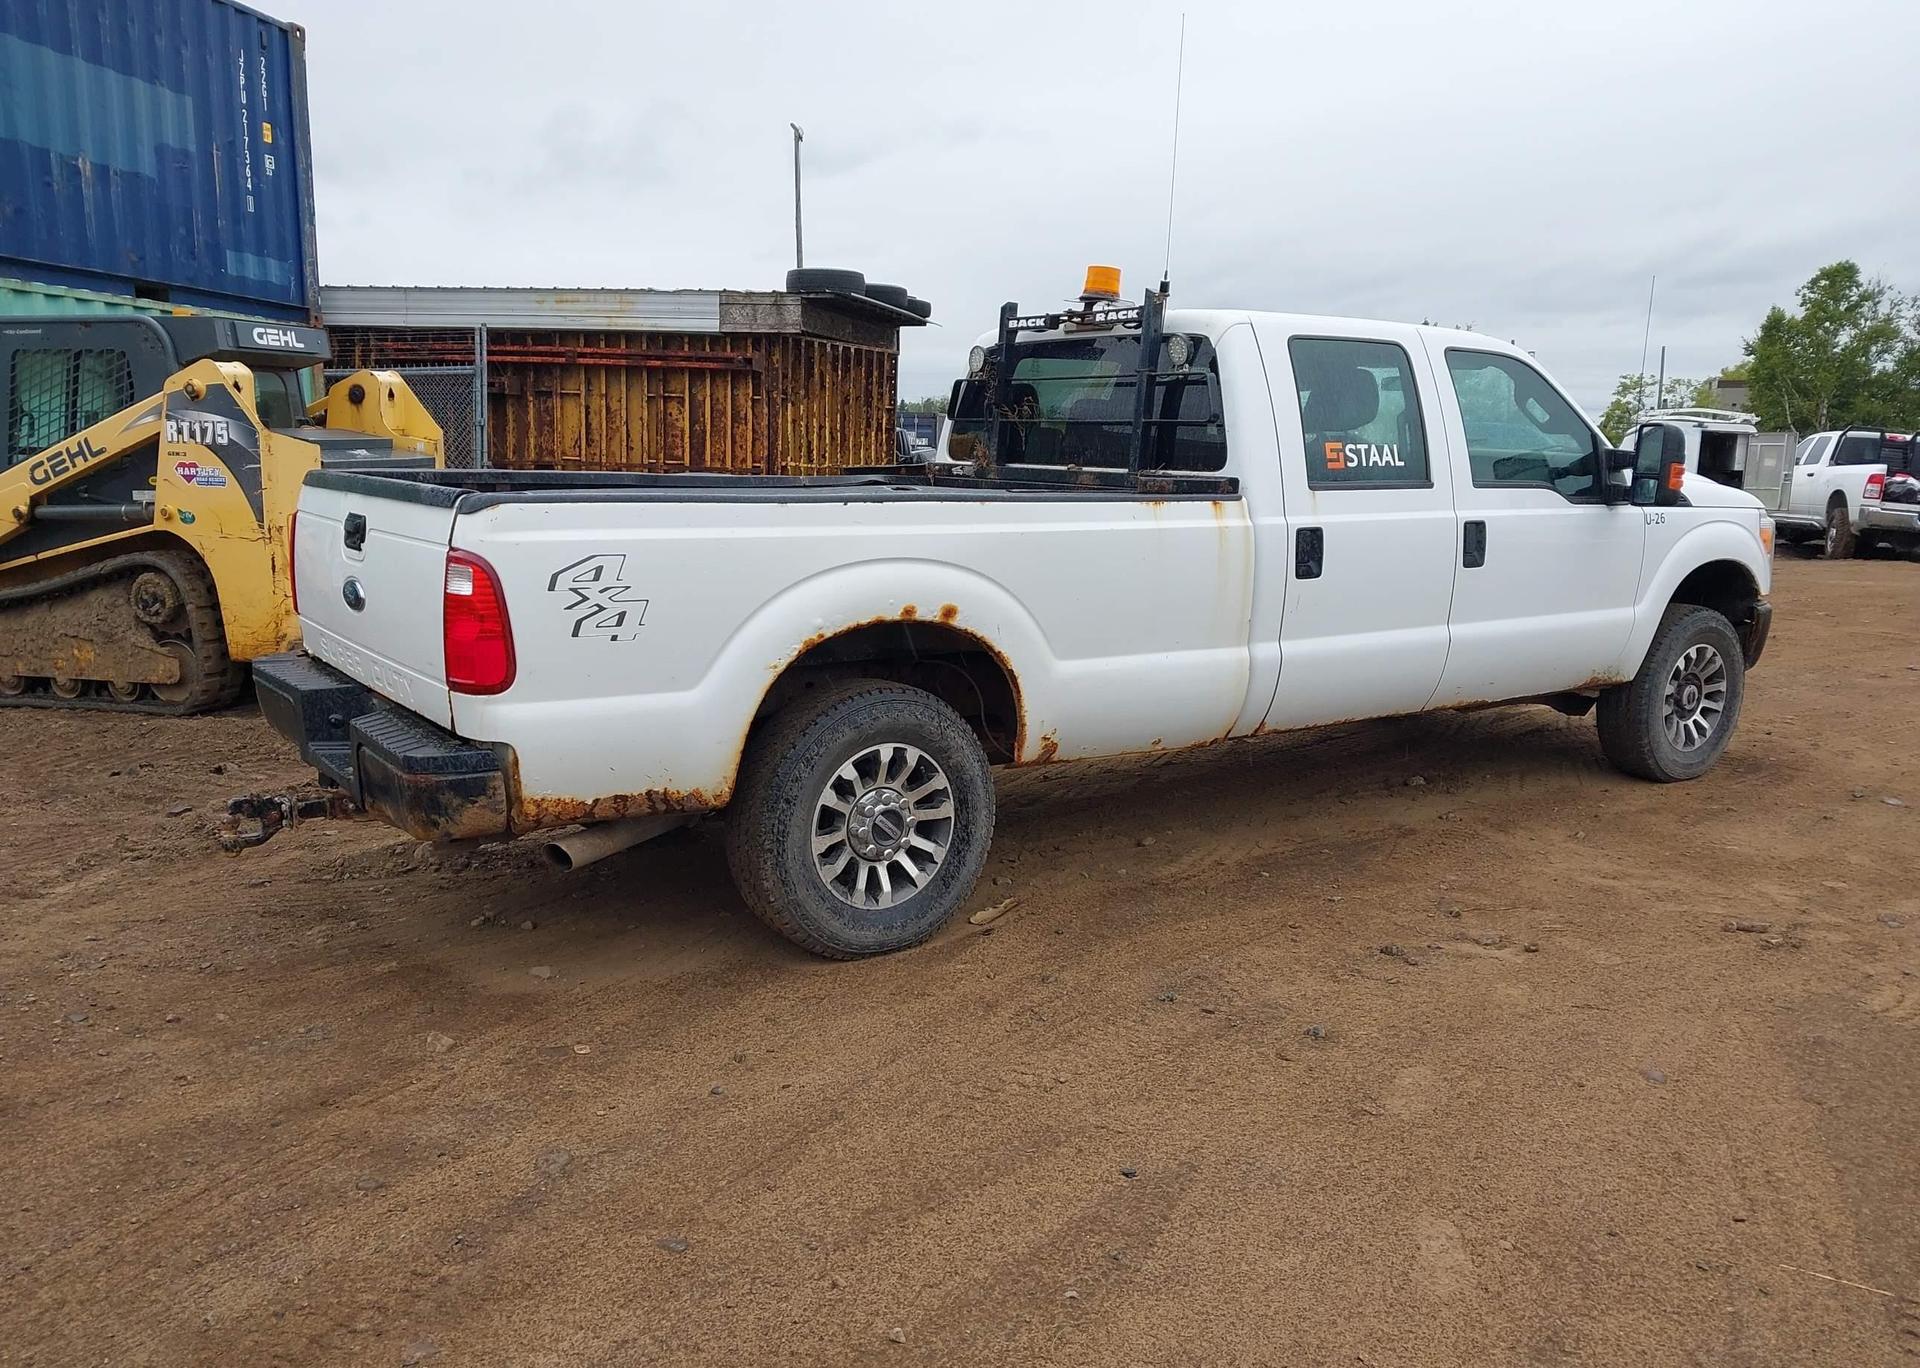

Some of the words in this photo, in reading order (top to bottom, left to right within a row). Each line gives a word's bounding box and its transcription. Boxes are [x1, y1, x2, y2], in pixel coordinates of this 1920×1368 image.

[1008, 318, 1046, 328] BACK
[1095, 309, 1140, 322] RACK
[252, 327, 305, 348] GEHL
[166, 420, 229, 446] RT175
[29, 436, 107, 485] GEHL
[1345, 443, 1405, 468] STAAL
[1645, 512, 1666, 525] U-26
